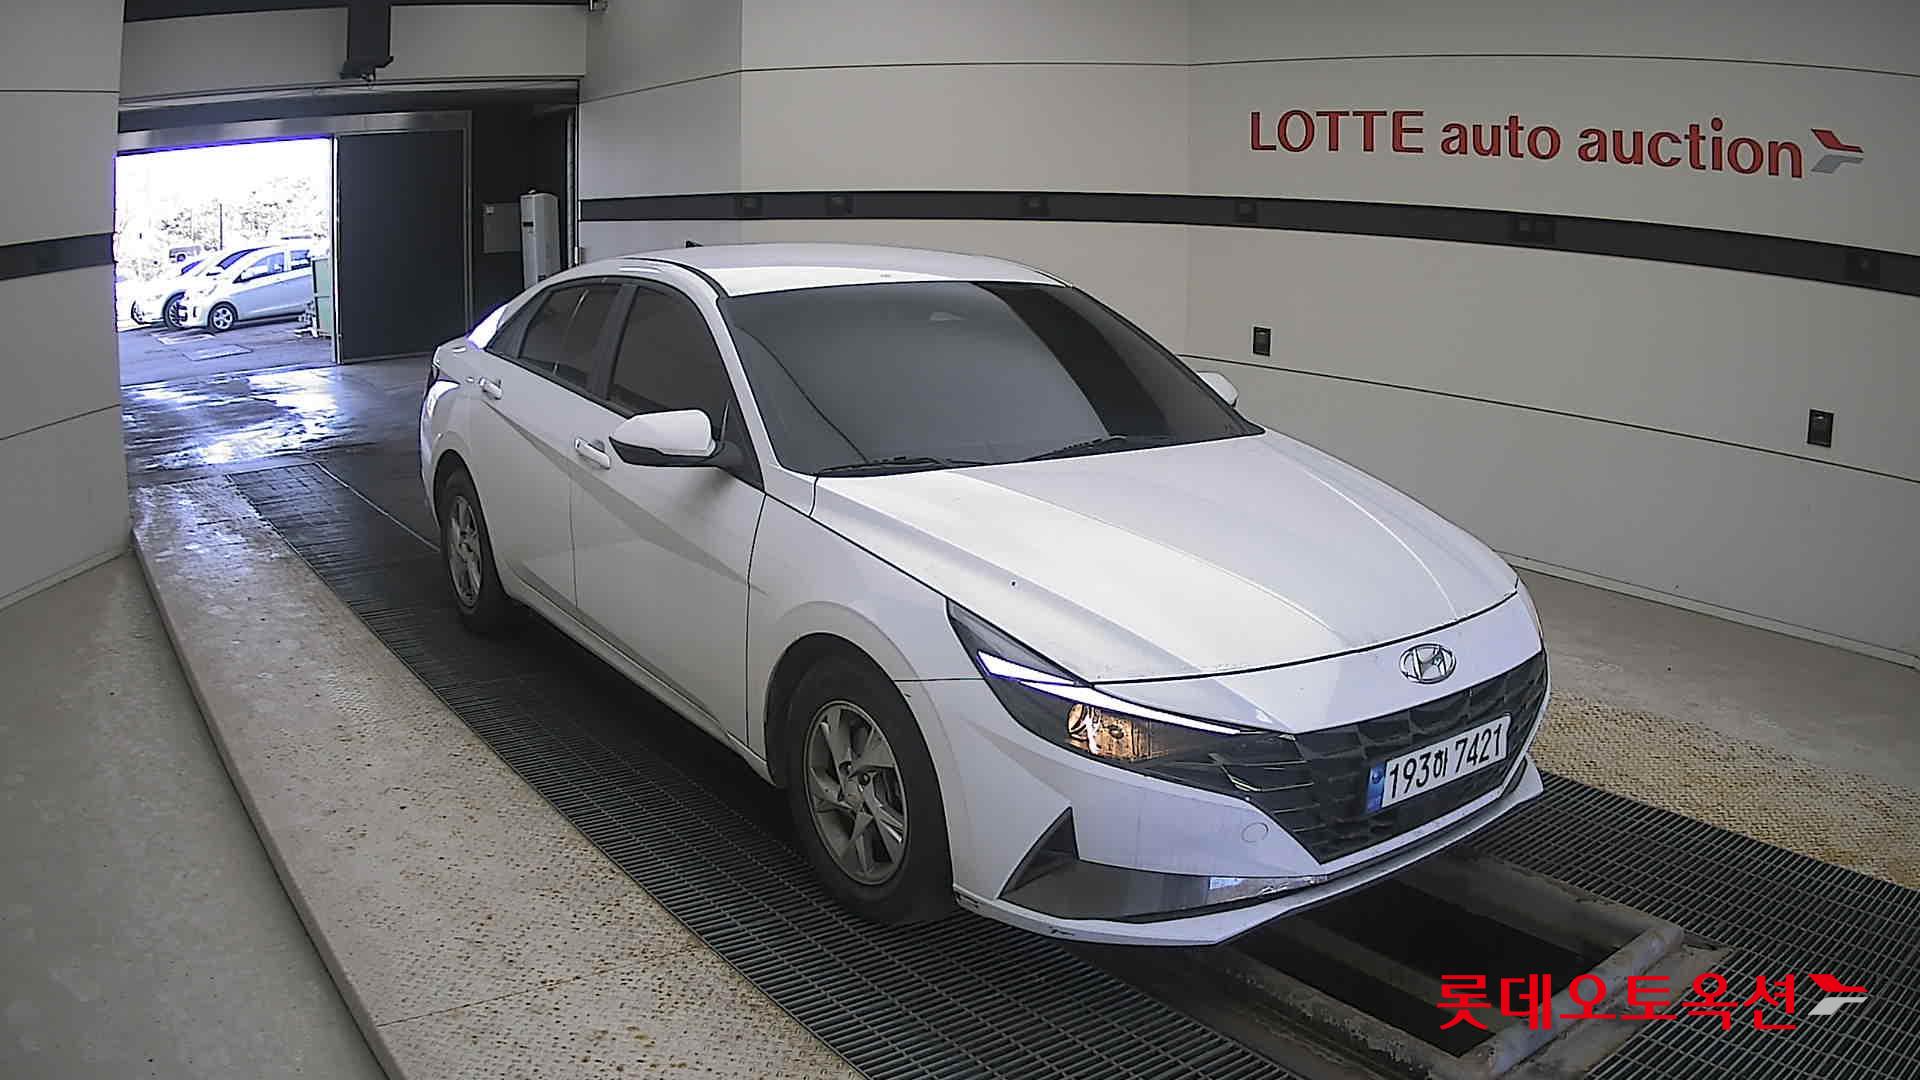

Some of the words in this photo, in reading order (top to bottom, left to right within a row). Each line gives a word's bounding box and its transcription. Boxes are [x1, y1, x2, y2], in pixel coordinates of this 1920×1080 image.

[1250, 109, 1425, 154] LOTTE
[1440, 115, 1562, 160] auto
[1577, 117, 1803, 179] auction
[1454, 723, 1503, 774] 7421
